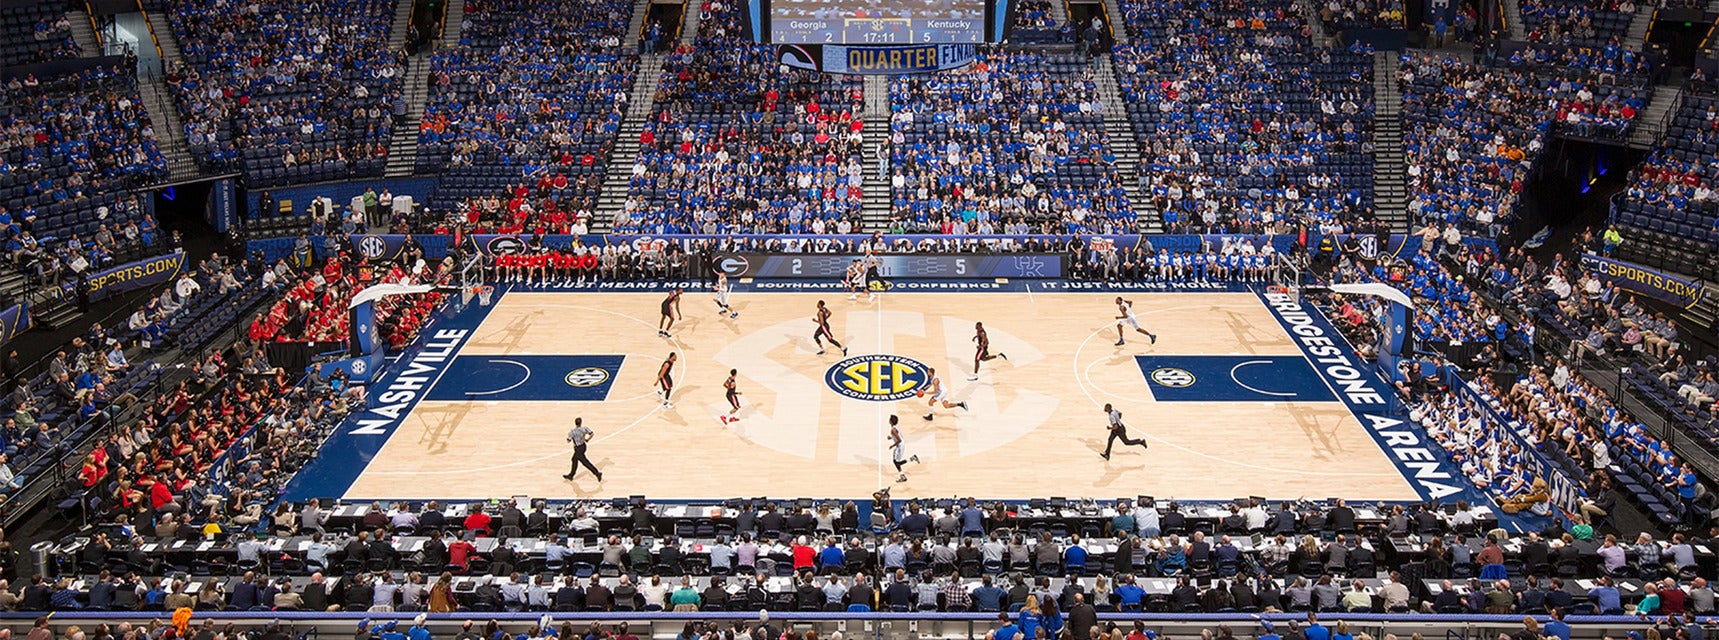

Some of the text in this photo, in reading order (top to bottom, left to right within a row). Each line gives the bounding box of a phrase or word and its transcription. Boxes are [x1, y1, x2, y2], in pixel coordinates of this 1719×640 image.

[790, 20, 827, 30] Georgia
[927, 20, 971, 30] Kentucky
[825, 33, 833, 42] 2
[863, 32, 895, 43] 17:11
[923, 33, 931, 42] 5
[850, 47, 938, 72] QUARTER
[361, 236, 383, 259] SEC
[792, 258, 802, 274] 2
[955, 258, 966, 275] 5
[600, 281, 658, 289] MEANS
[1041, 281, 1057, 289] IT
[1061, 281, 1104, 289] JUST
[1106, 281, 1167, 289] MEANS
[840, 355, 920, 368] SOUTHEASTERN
[348, 328, 468, 435] NASHVILLE
[841, 360, 919, 395] SEC
[1264, 292, 1464, 500] BRIDGESTONE ARENA
